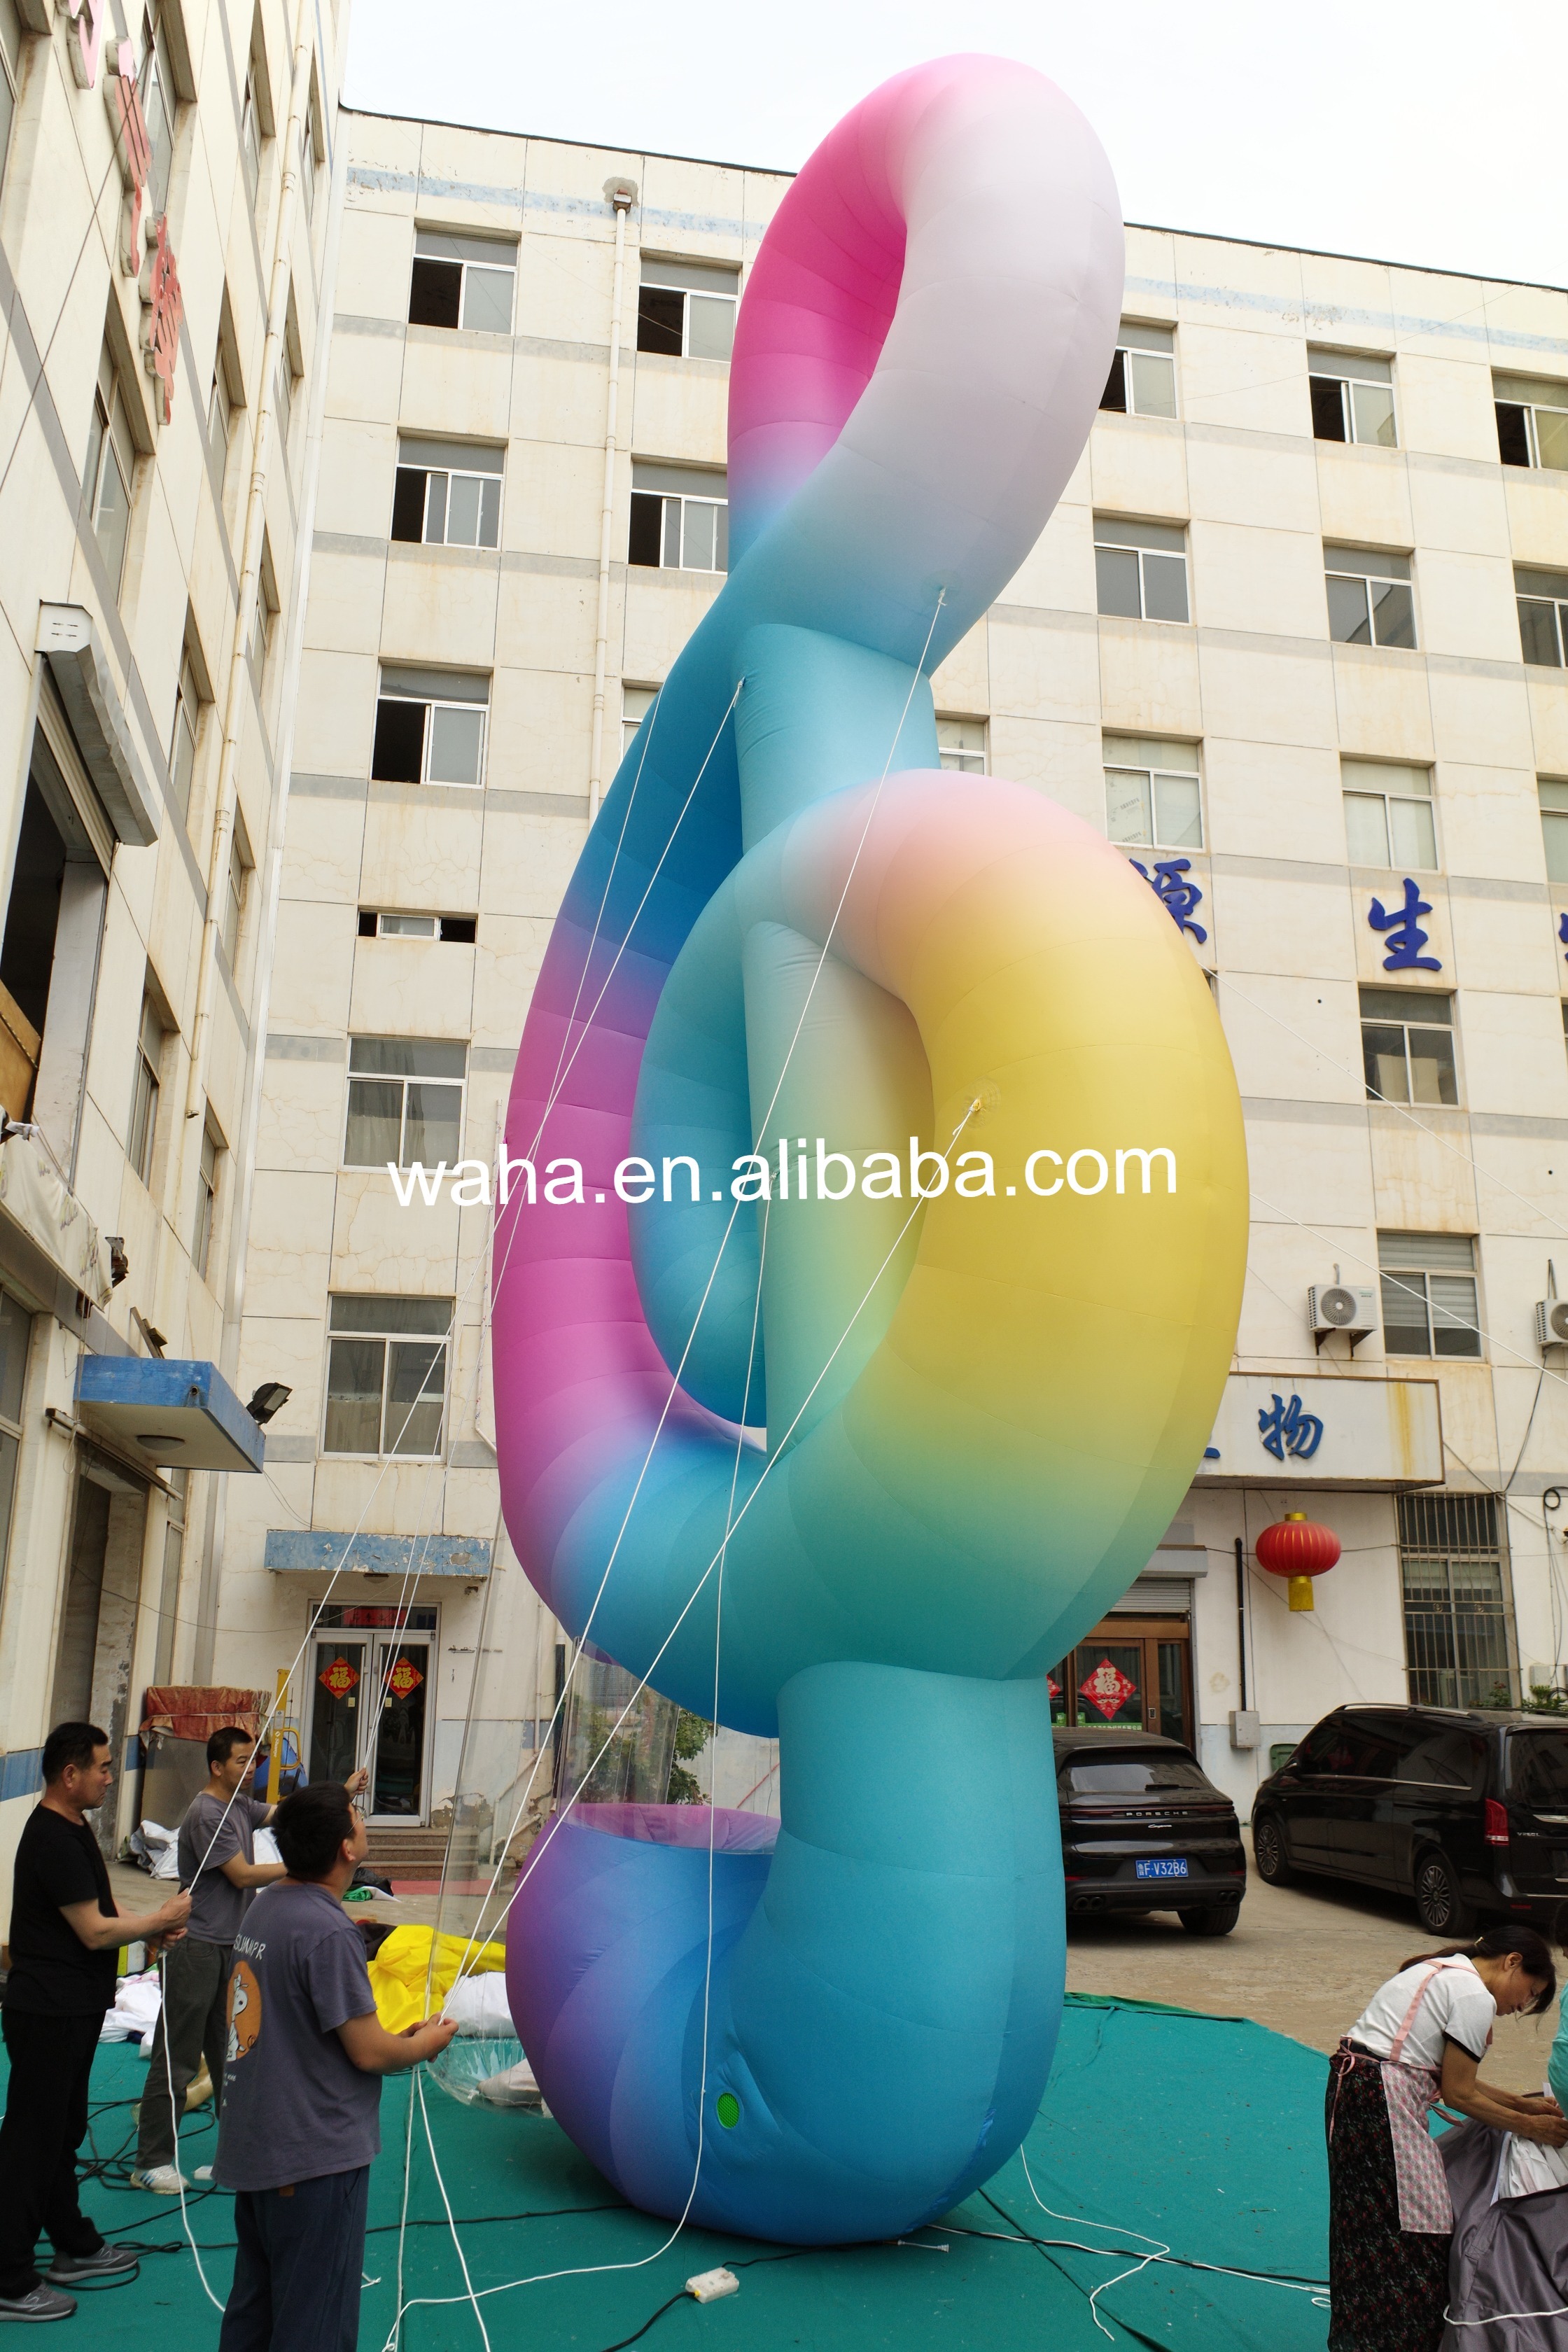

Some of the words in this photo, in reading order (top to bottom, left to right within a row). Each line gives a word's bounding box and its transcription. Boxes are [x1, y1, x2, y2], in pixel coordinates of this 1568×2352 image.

[329, 1667, 351, 1689] 福
[392, 1667, 414, 1689] 福
[1093, 1667, 1121, 1695] 福
